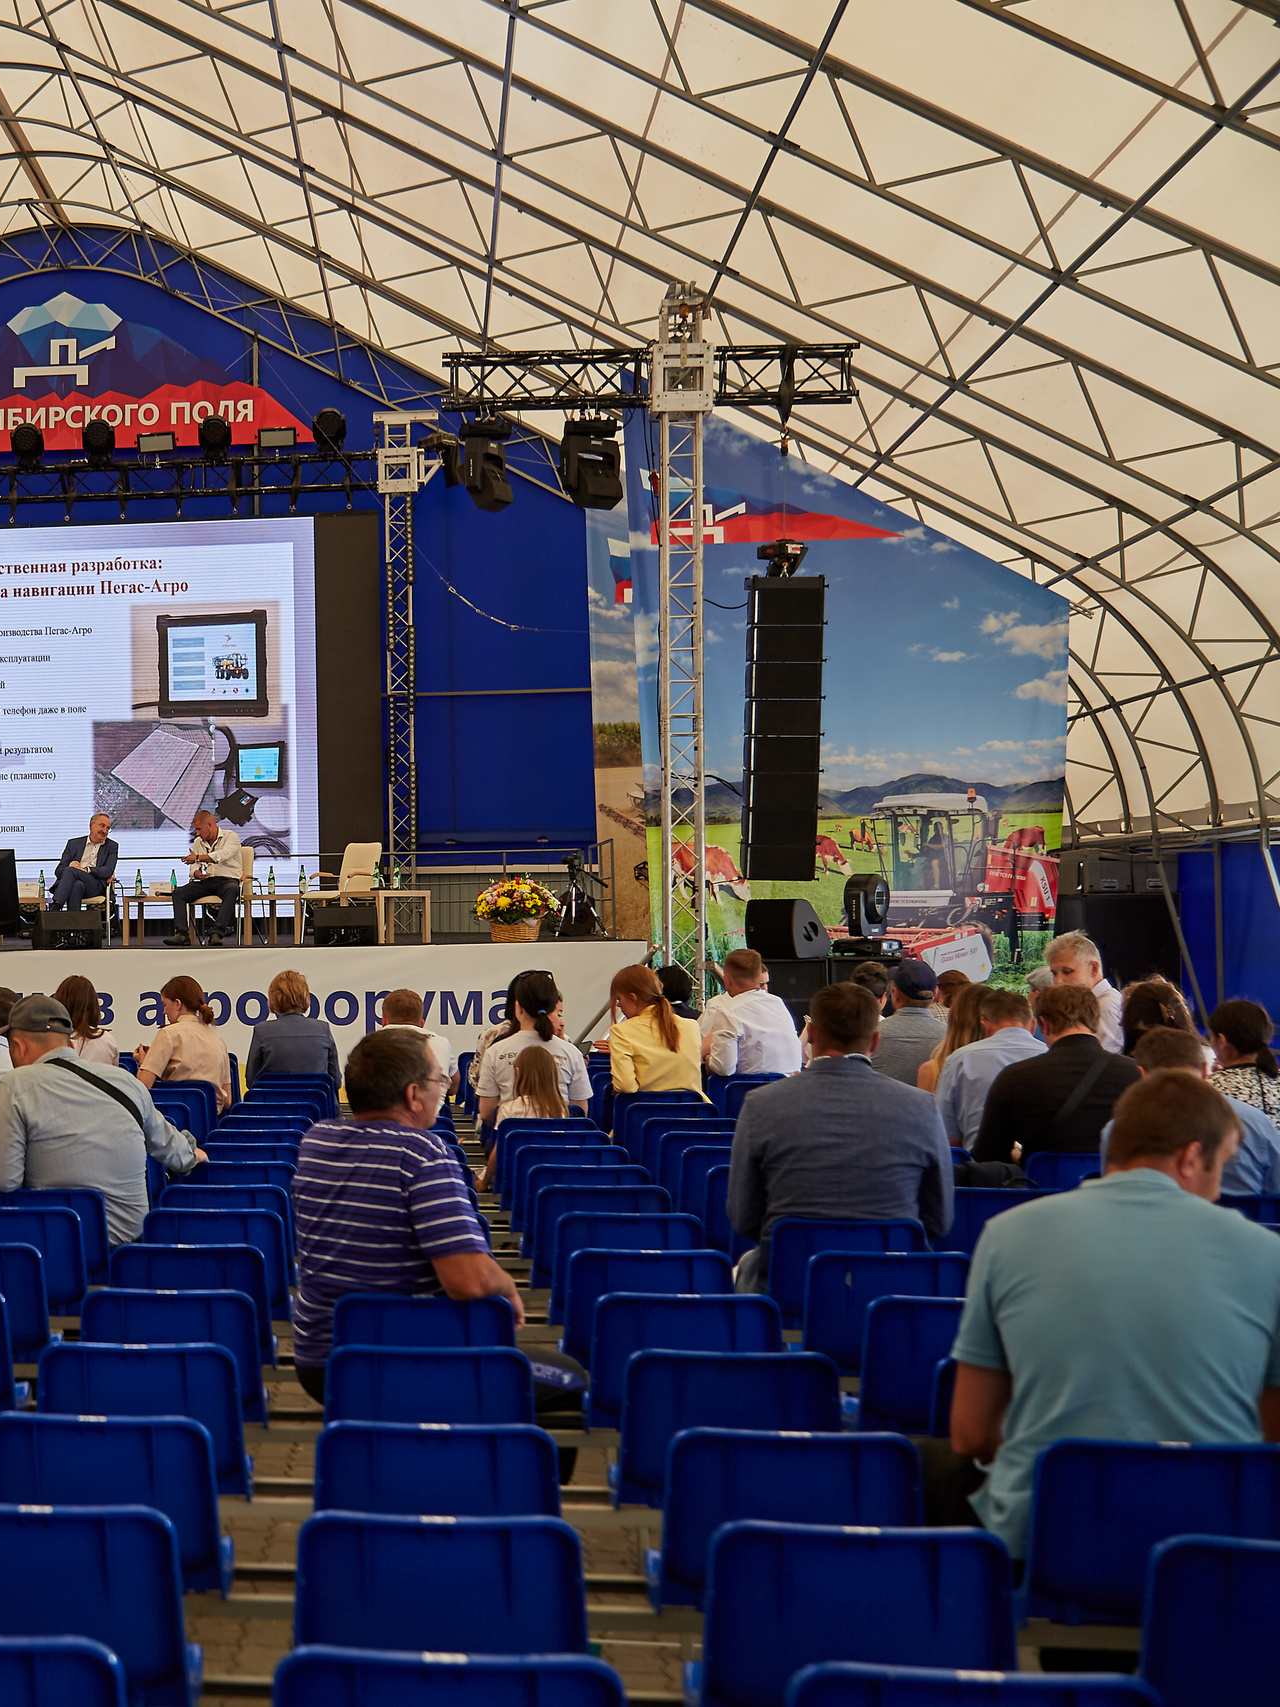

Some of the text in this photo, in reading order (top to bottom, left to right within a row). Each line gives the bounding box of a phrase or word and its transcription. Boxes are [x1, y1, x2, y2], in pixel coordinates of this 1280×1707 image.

[171, 399, 254, 425] ПОЛЯ
[71, 556, 163, 576] разработка:
[13, 584, 95, 598] навигации
[100, 578, 189, 596] Пегас-Агро
[45, 626, 93, 637] Пегас-Агро
[3, 705, 36, 717] телефон
[38, 706, 58, 715] даже
[67, 706, 87, 714] поле
[4, 746, 53, 756] результатом
[10, 770, 57, 782] (планшете)
